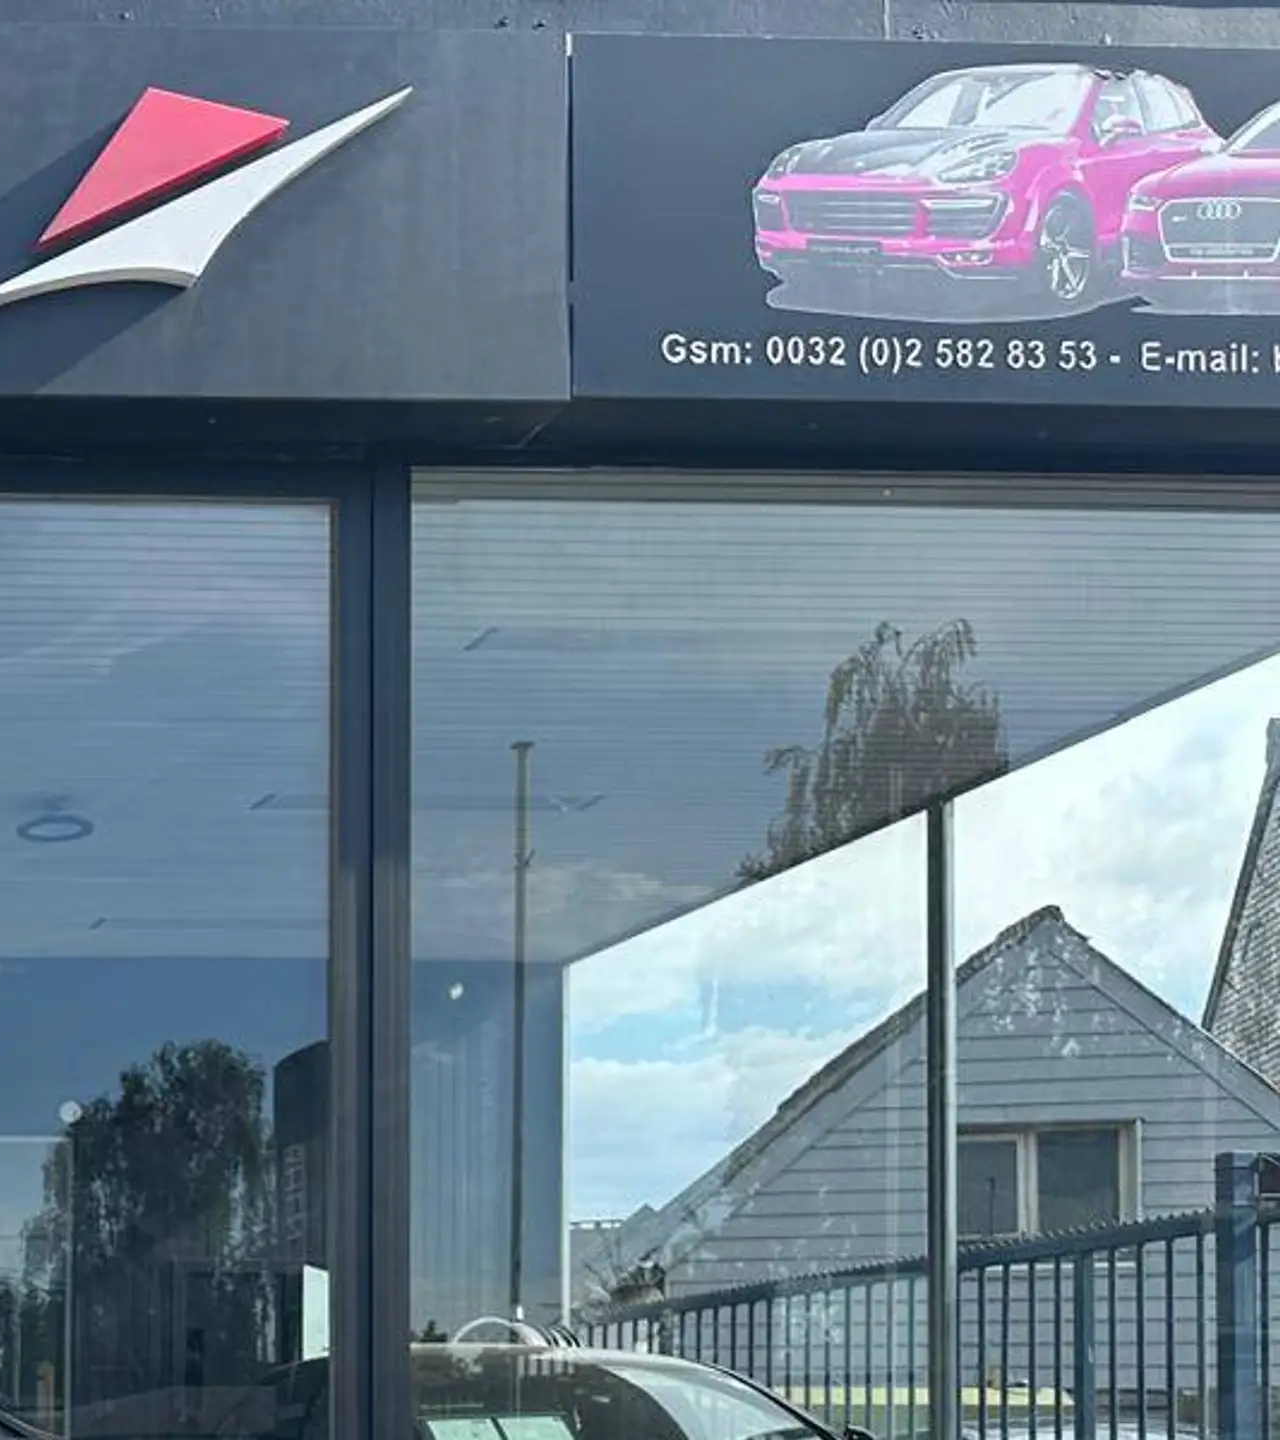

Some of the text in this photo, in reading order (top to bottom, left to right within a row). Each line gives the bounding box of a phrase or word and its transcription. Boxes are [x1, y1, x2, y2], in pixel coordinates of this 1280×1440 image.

[661, 333, 751, 364] Gsm:
[765, 335, 846, 365] 0032
[859, 336, 921, 374] (0)2
[936, 338, 994, 368] 582
[1007, 340, 1045, 369] 83
[1058, 341, 1097, 370] 53
[1141, 340, 1260, 374] E-mail:
